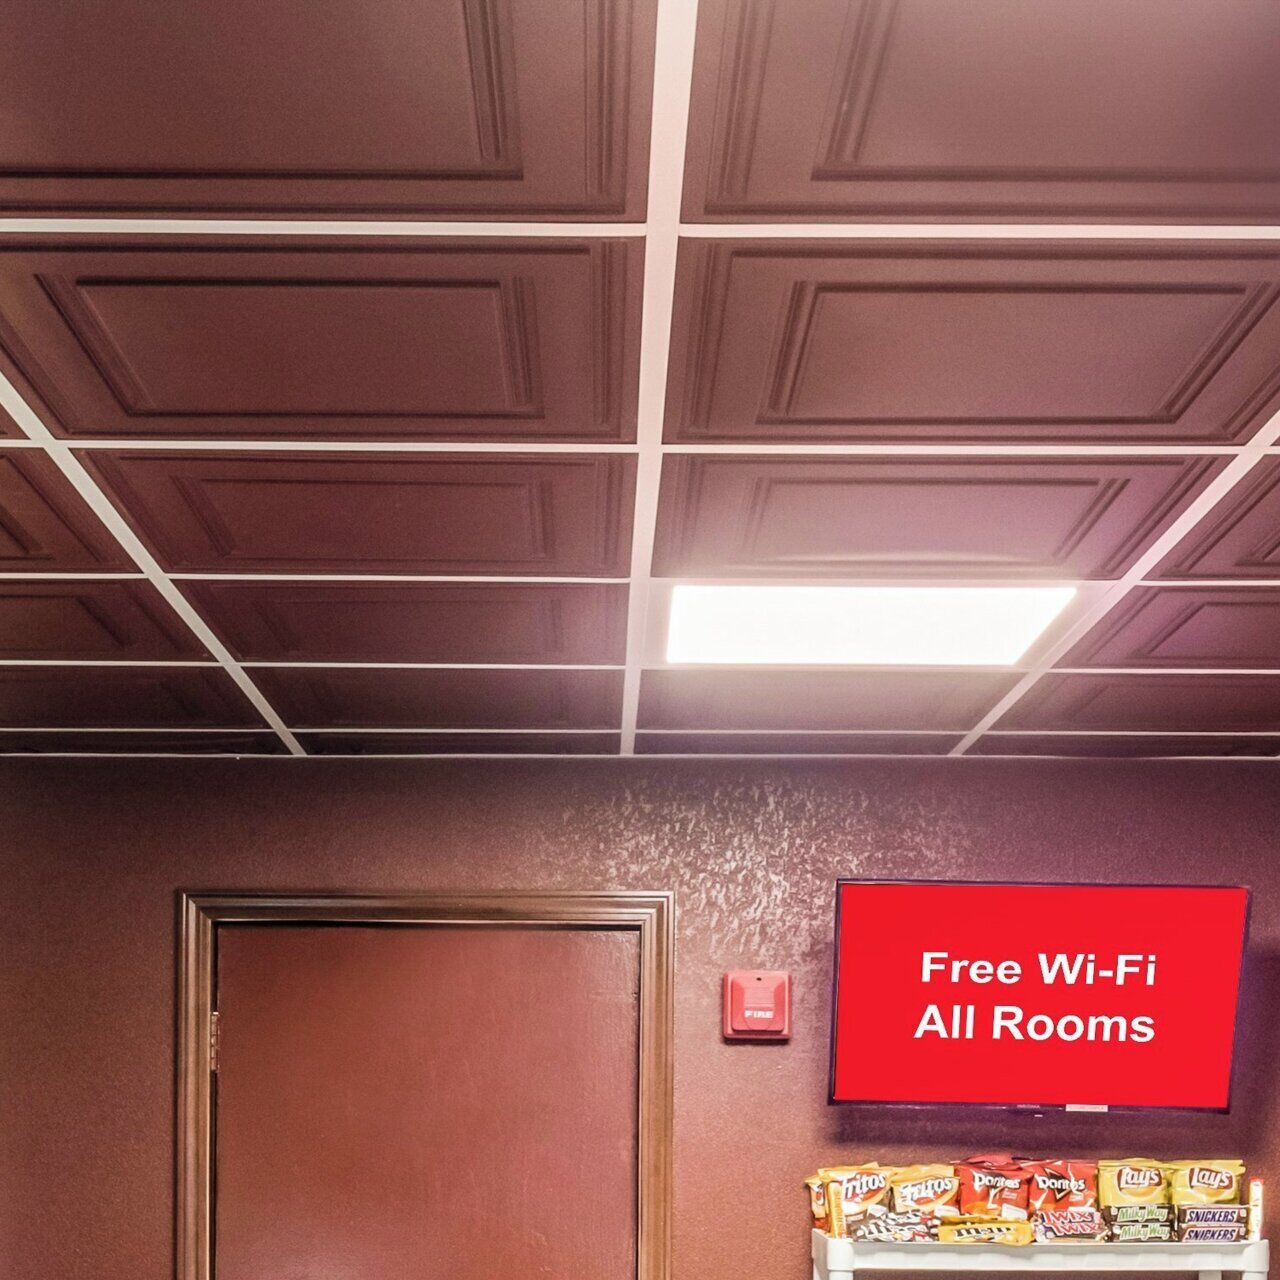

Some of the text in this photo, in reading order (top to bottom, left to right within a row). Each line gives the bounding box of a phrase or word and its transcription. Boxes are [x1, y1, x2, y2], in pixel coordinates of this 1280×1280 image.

[920, 951, 1156, 986] Free Wi-Fi
[914, 1004, 1156, 1043] All Rooms
[841, 1173, 886, 1200] Fritos
[901, 1177, 953, 1201] Fritos
[1187, 1210, 1236, 1223] SNICKERS
[1185, 1229, 1236, 1241] SNICKERS
